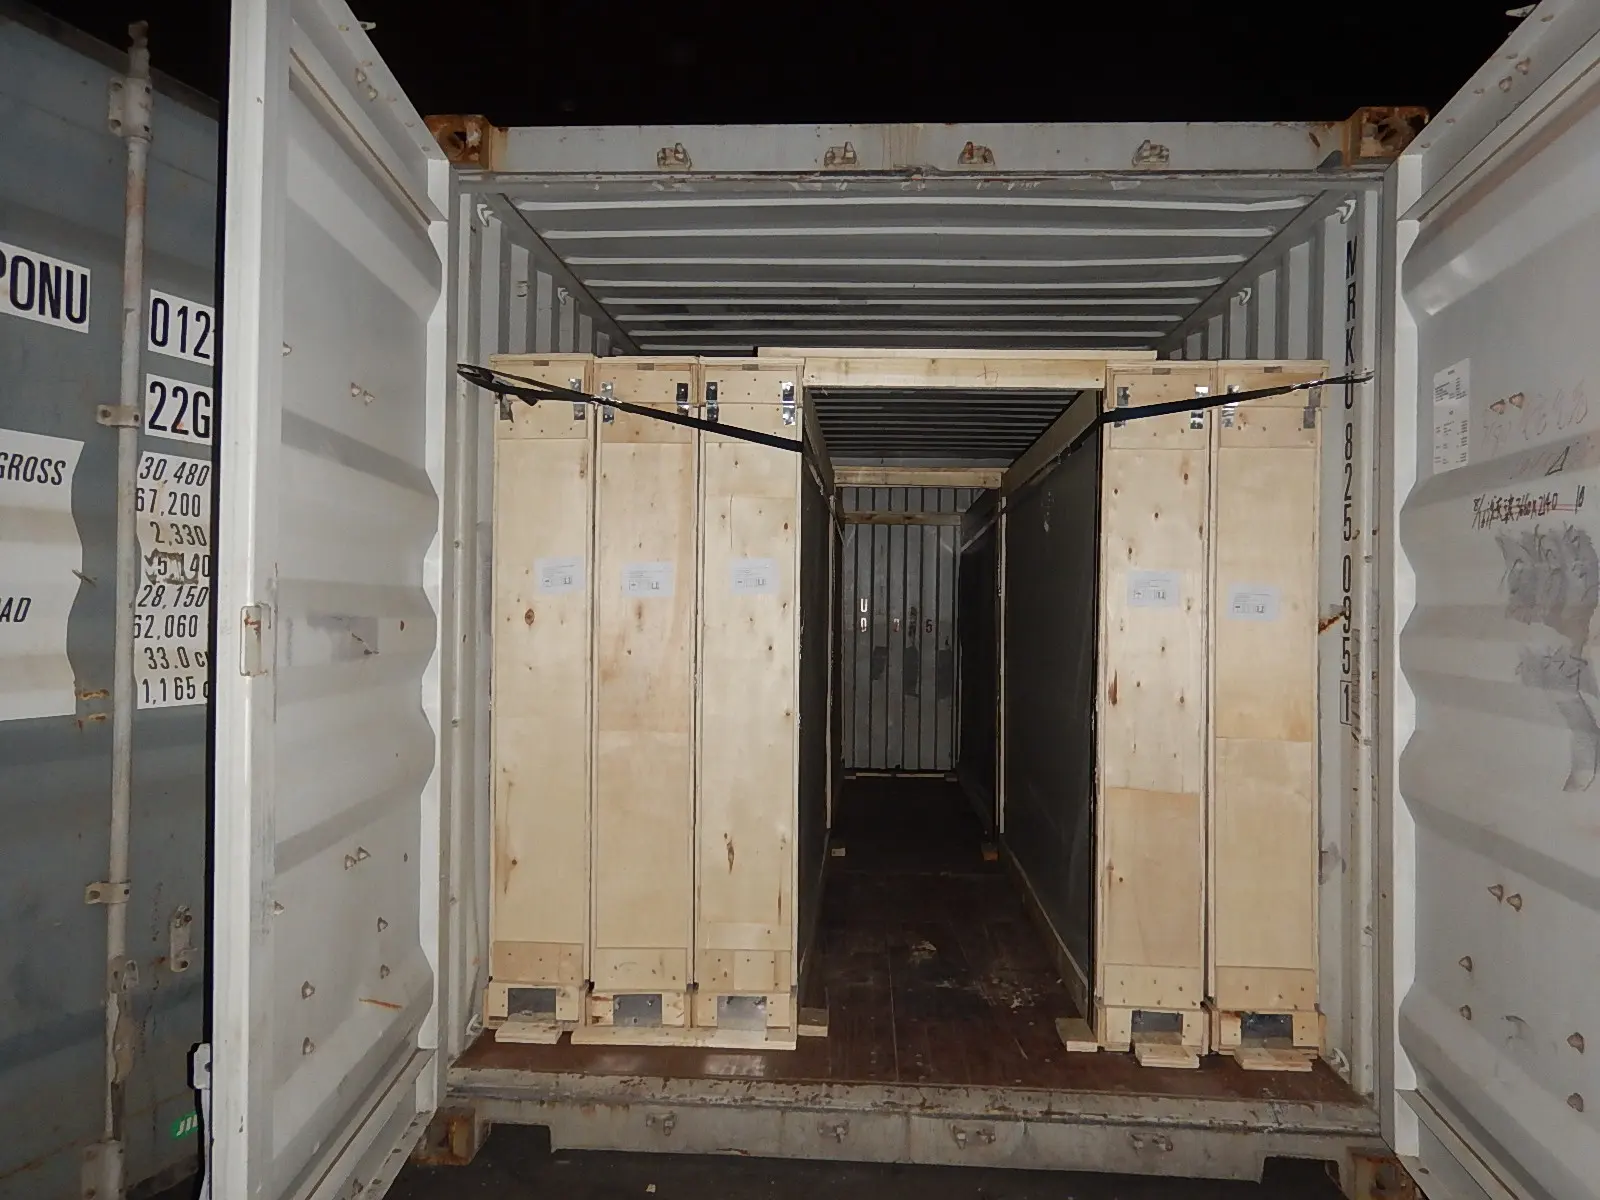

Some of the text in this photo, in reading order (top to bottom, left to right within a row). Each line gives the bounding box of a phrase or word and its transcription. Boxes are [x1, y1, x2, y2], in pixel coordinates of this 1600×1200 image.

[150, 297, 211, 360] 012
[148, 381, 211, 439] 22G
[140, 456, 210, 487] 30,480
[135, 487, 201, 517] 67,200
[149, 521, 207, 546] 2,330
[0, 597, 31, 622] AD
[137, 584, 209, 609] 28,150
[144, 646, 190, 670] 33.0
[142, 676, 196, 705] 1,165
